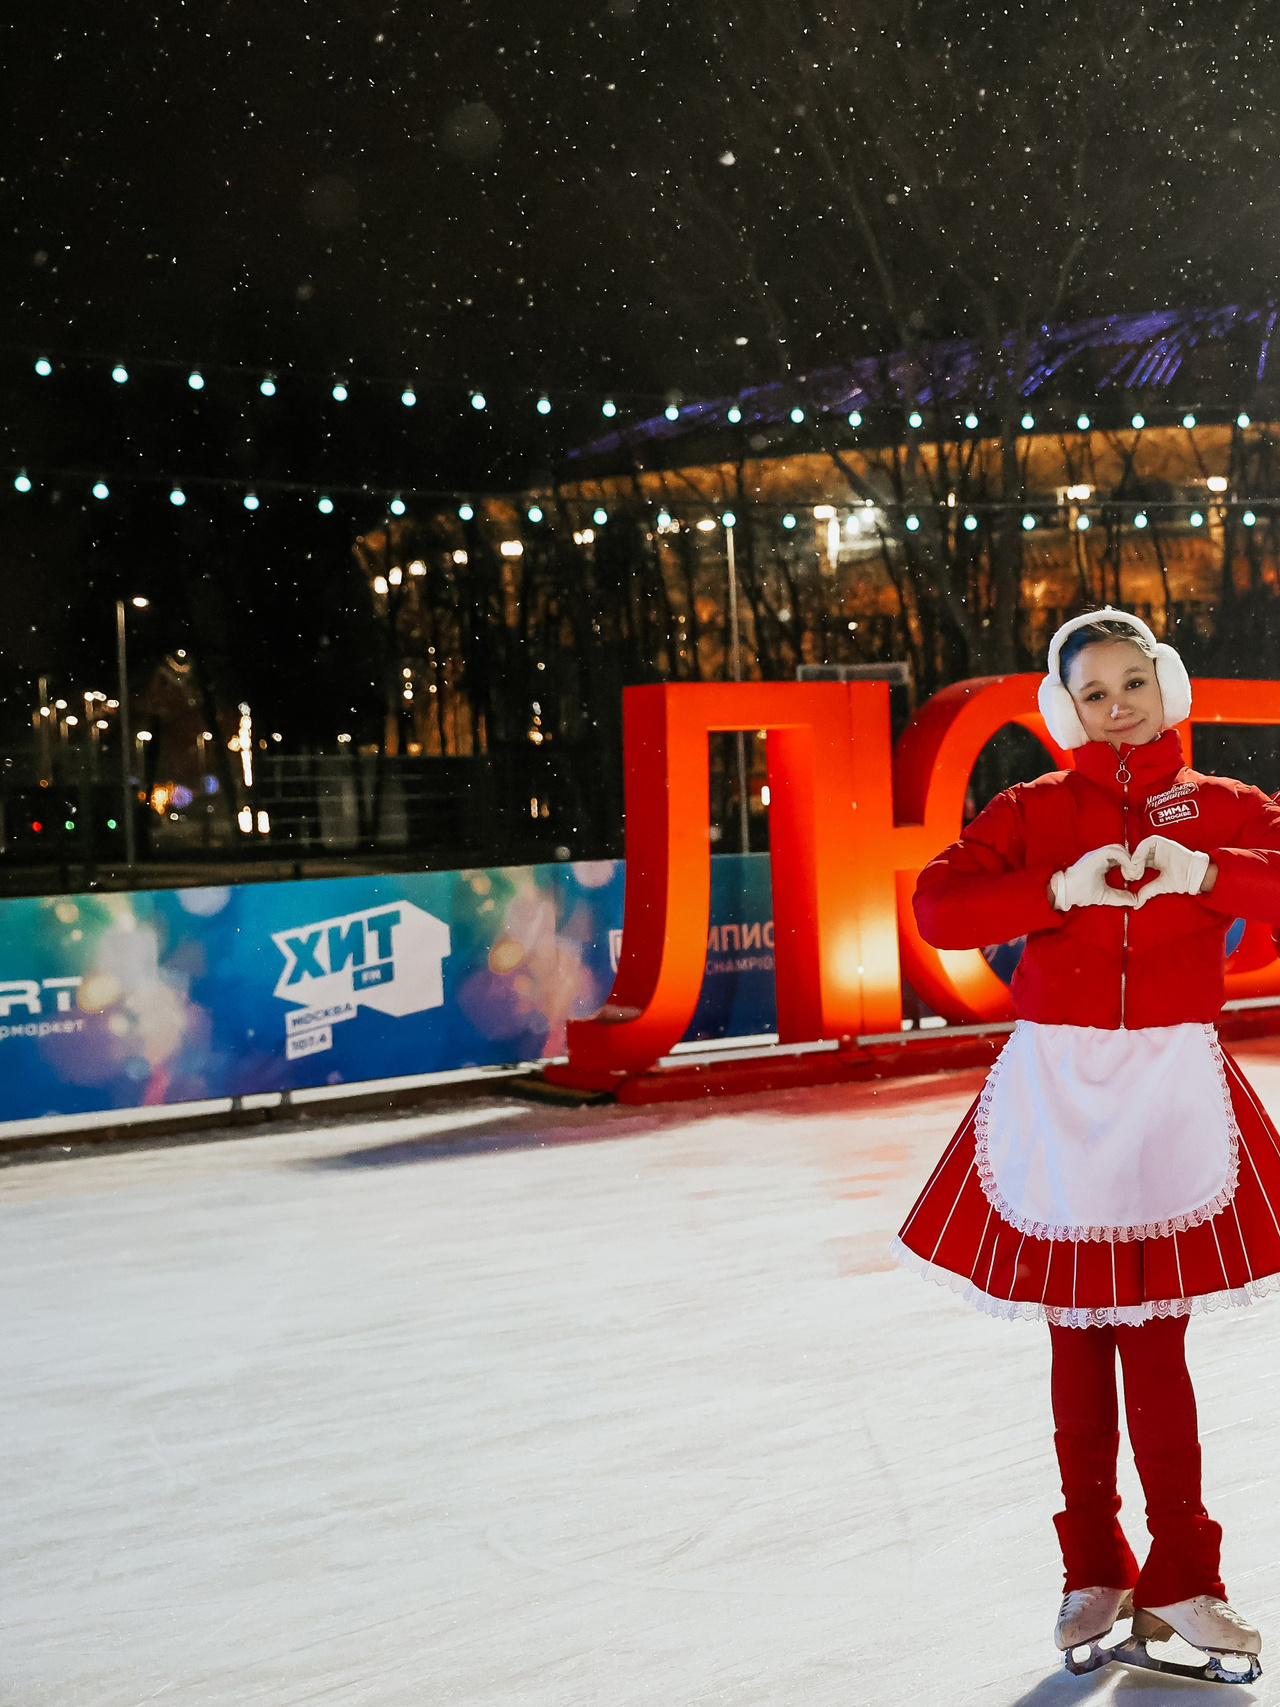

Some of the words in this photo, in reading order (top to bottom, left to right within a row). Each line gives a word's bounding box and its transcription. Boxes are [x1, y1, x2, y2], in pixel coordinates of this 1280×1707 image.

[1157, 804, 1191, 819] ЗИМА
[1165, 810, 1192, 821] МОСКВЕ
[284, 910, 401, 986] ХИТ
[705, 956, 775, 975] CHAMPIO
[291, 1004, 353, 1027] МОСКВА
